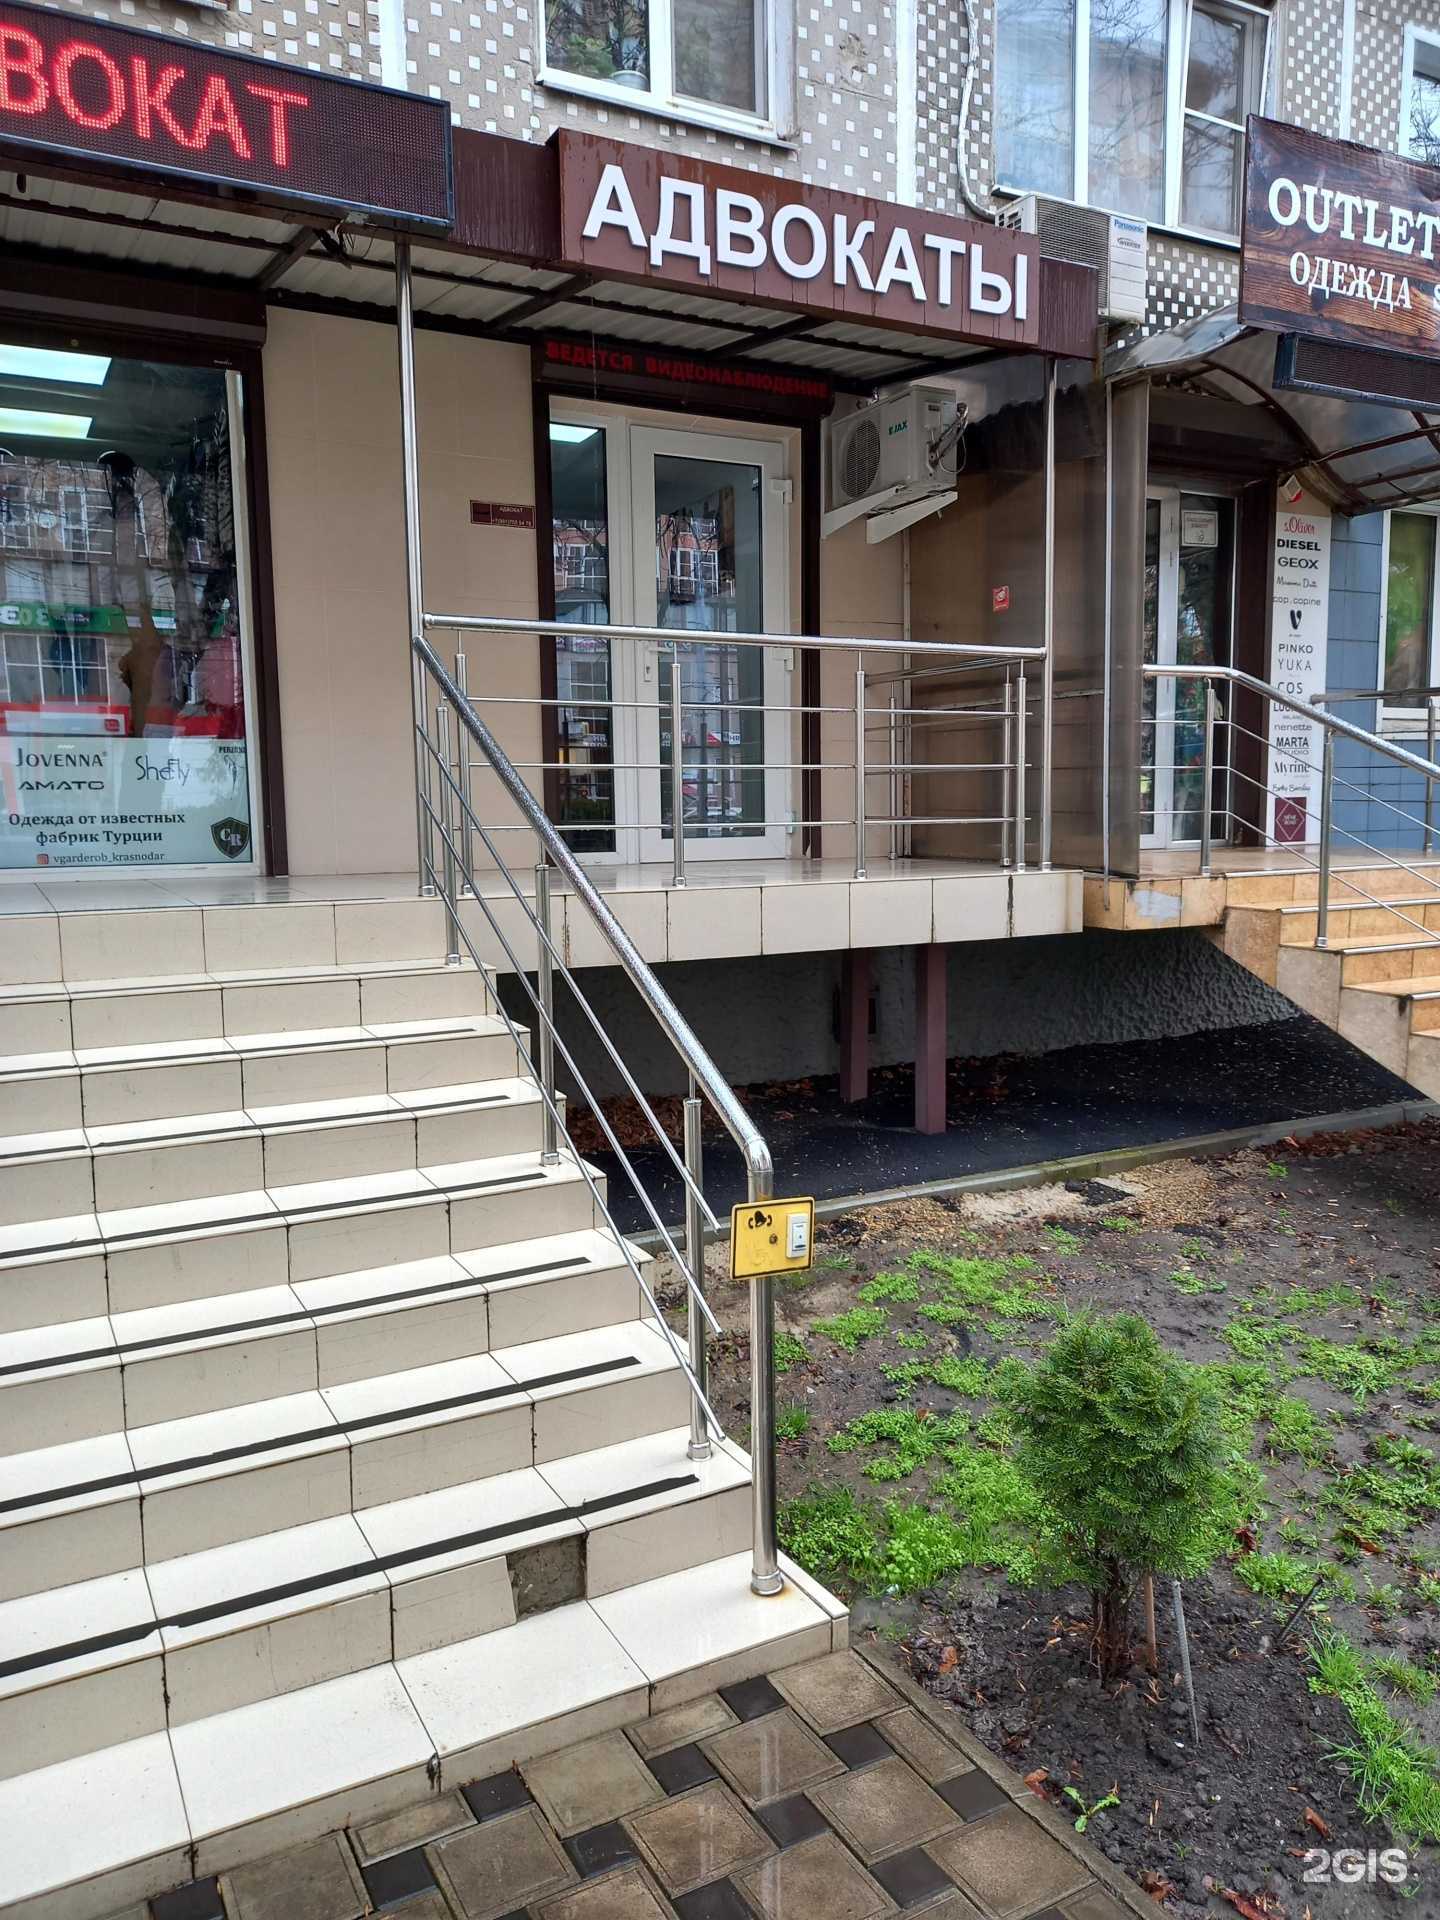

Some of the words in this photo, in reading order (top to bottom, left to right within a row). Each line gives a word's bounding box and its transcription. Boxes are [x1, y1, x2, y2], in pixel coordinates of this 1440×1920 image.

[1268, 177, 1440, 261] OUTLET
[582, 163, 1028, 321] АДВОКАТЫ
[1289, 251, 1413, 313] ОДЕЖДА
[1276, 538, 1321, 551] DIESEL
[1278, 556, 1319, 570] GEOX
[1278, 643, 1313, 654] PINKO
[1278, 658, 1312, 671] YUKA
[1278, 681, 1303, 694] COS
[1276, 736, 1309, 748] MARTA
[15, 748, 103, 767] JOVENNA
[18, 780, 105, 790] AMATO
[9, 814, 74, 826] Одежда
[78, 816, 97, 825] от
[101, 813, 186, 824] известных
[36, 831, 100, 846] фабрик
[103, 830, 163, 844] Турции
